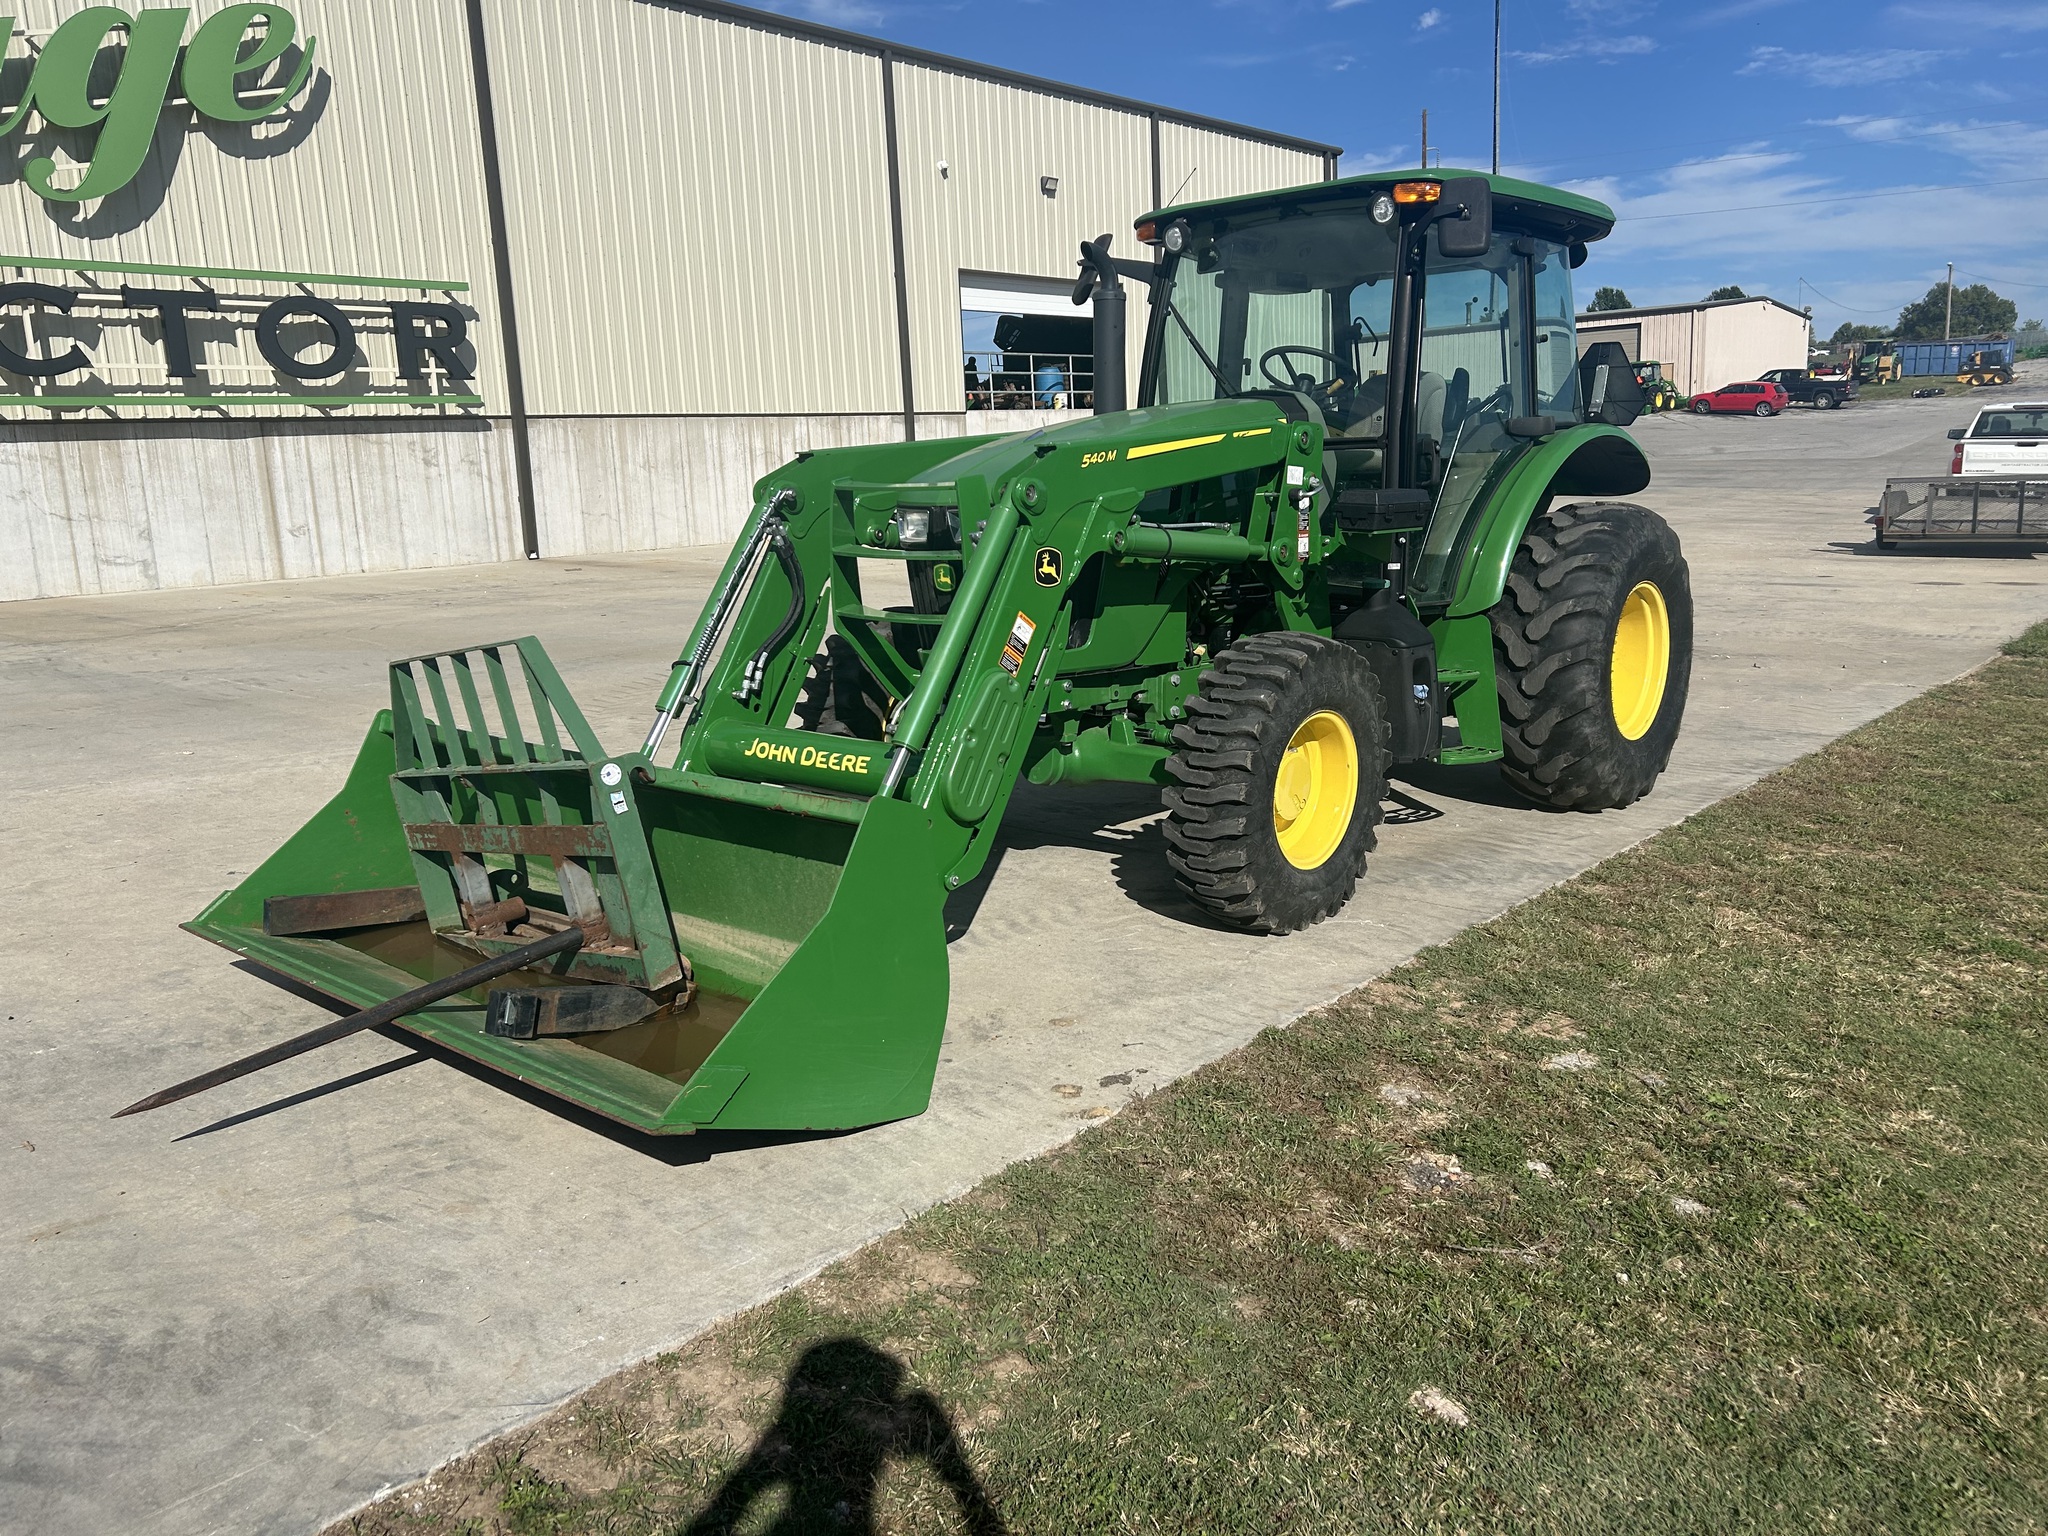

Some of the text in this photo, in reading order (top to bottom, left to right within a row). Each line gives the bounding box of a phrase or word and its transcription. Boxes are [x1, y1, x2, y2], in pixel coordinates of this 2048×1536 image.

[0, 3, 316, 201] ge
[0, 283, 476, 381] CTOR
[744, 738, 871, 774] JOHN DEERE
